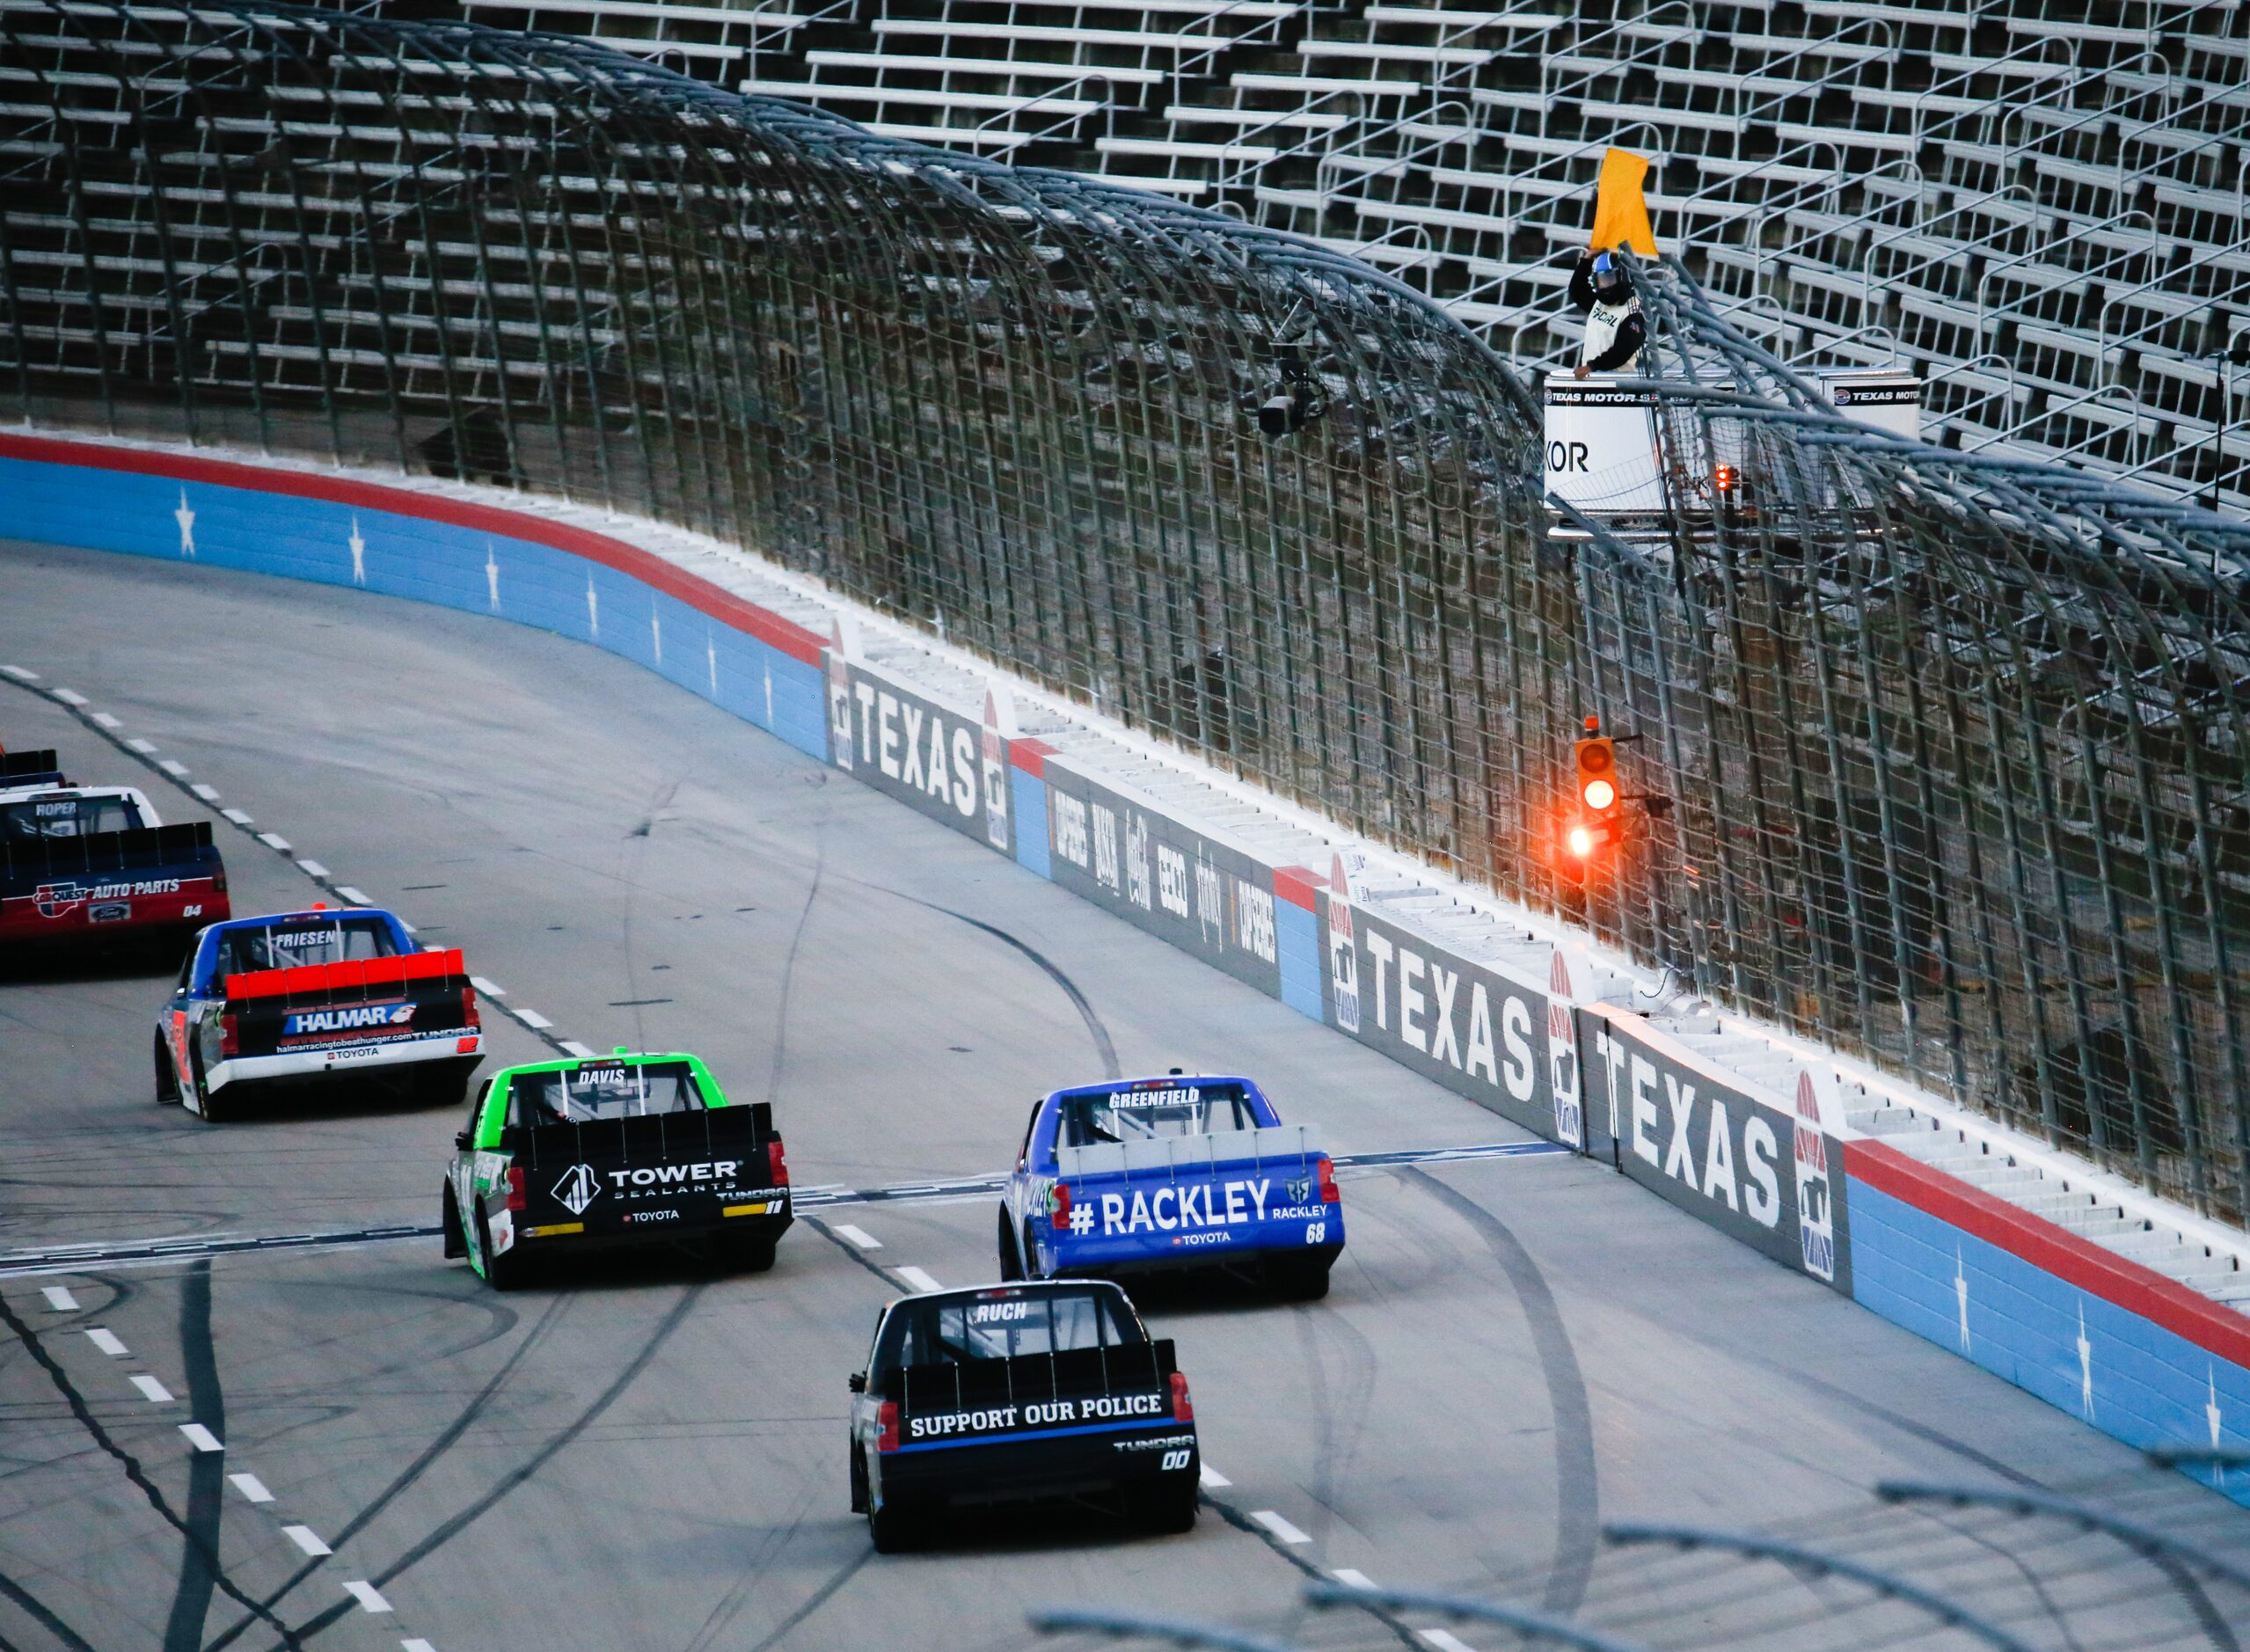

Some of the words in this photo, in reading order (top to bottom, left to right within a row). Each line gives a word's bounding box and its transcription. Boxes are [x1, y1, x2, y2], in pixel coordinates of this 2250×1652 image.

[1552, 392, 1582, 402] TEXAS
[1584, 392, 1636, 403] MOTOR
[1852, 391, 1894, 401] TEXAS
[855, 680, 976, 817] TEXAS
[36, 801, 77, 817] ROPER
[92, 882, 132, 900] AUTO
[134, 879, 179, 895] PARTS
[183, 904, 202, 917] 04
[275, 930, 336, 949] FRIESEN
[296, 1006, 387, 1033] HALMAR
[1366, 927, 1535, 1102] TEXAS
[276, 1033, 412, 1054] halmarracingtobeathunger.com
[336, 1047, 379, 1060] TOYOTA
[579, 1068, 626, 1086] DAVIS
[1108, 1086, 1200, 1109] GREENFIELD
[1596, 1029, 1781, 1229] TEXAS
[609, 1159, 741, 1187] TOWER
[614, 1181, 736, 1199] SEALANTS
[716, 1187, 788, 1201] TUNDRA
[632, 1209, 680, 1224] TOYOTA
[764, 1200, 784, 1215] 11
[1272, 1203, 1327, 1219] RACKLEY
[1182, 1232, 1231, 1246] TOYOTA
[1305, 1222, 1326, 1244] 68
[976, 1302, 1027, 1322] RUCH
[910, 1407, 1019, 1437] SUPPORT
[1025, 1401, 1075, 1425] OUR
[1081, 1394, 1162, 1419] POLICE
[1113, 1435, 1195, 1452] TUNDRA
[1161, 1449, 1191, 1471] 00
